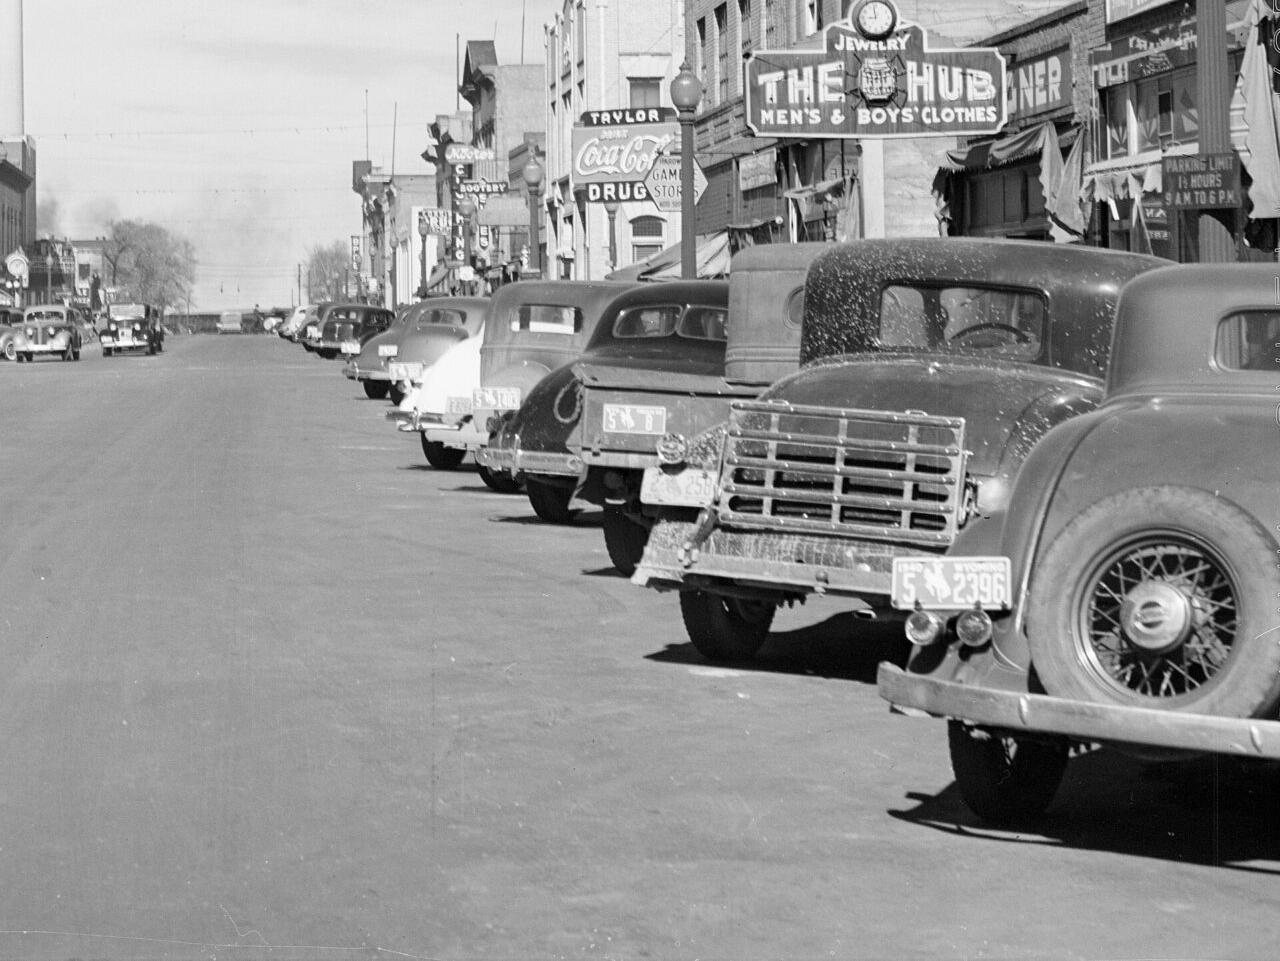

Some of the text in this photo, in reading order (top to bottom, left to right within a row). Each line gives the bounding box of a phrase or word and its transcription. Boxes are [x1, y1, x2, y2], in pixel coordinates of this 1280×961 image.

[834, 33, 911, 51] JEWELRY
[758, 61, 846, 104] THE
[906, 60, 997, 102] HUB
[590, 109, 660, 125] TAYLOR
[760, 106, 997, 125] MEN'S & BOYS' CLOTHES
[575, 134, 674, 176] Coca-Col
[1166, 156, 1234, 173] PARKING LIMIT
[460, 183, 506, 194] BOOTERY
[1190, 174, 1223, 189] HOURS
[654, 184, 699, 198] STORS
[1165, 192, 1172, 206] 9
[1194, 191, 1206, 205] TO
[1208, 191, 1216, 205] 6
[608, 413, 616, 430] 5
[903, 572, 1006, 604] 5 2396
